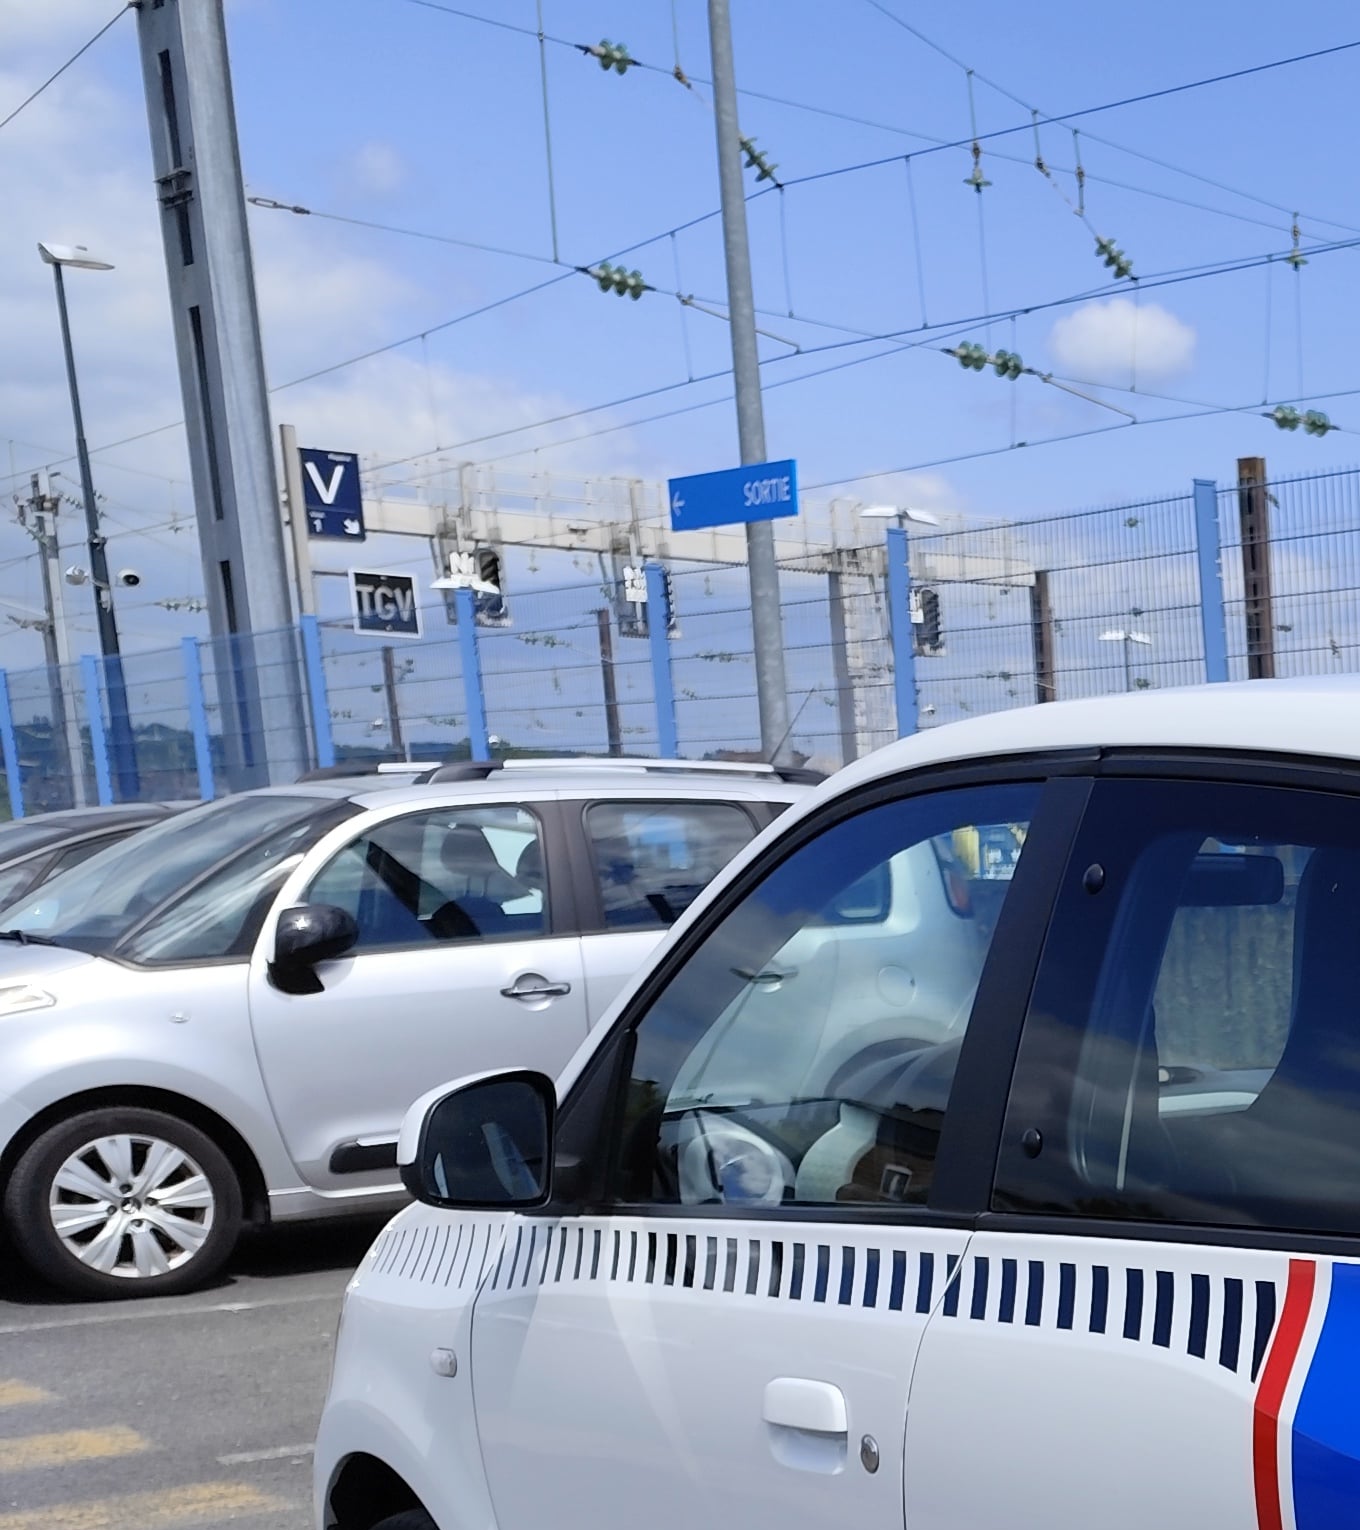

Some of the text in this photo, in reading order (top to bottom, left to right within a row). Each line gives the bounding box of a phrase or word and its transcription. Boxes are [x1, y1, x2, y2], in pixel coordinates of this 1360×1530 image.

[305, 462, 345, 504] V
[743, 476, 791, 507] SORTIE
[355, 584, 414, 622] TGV
